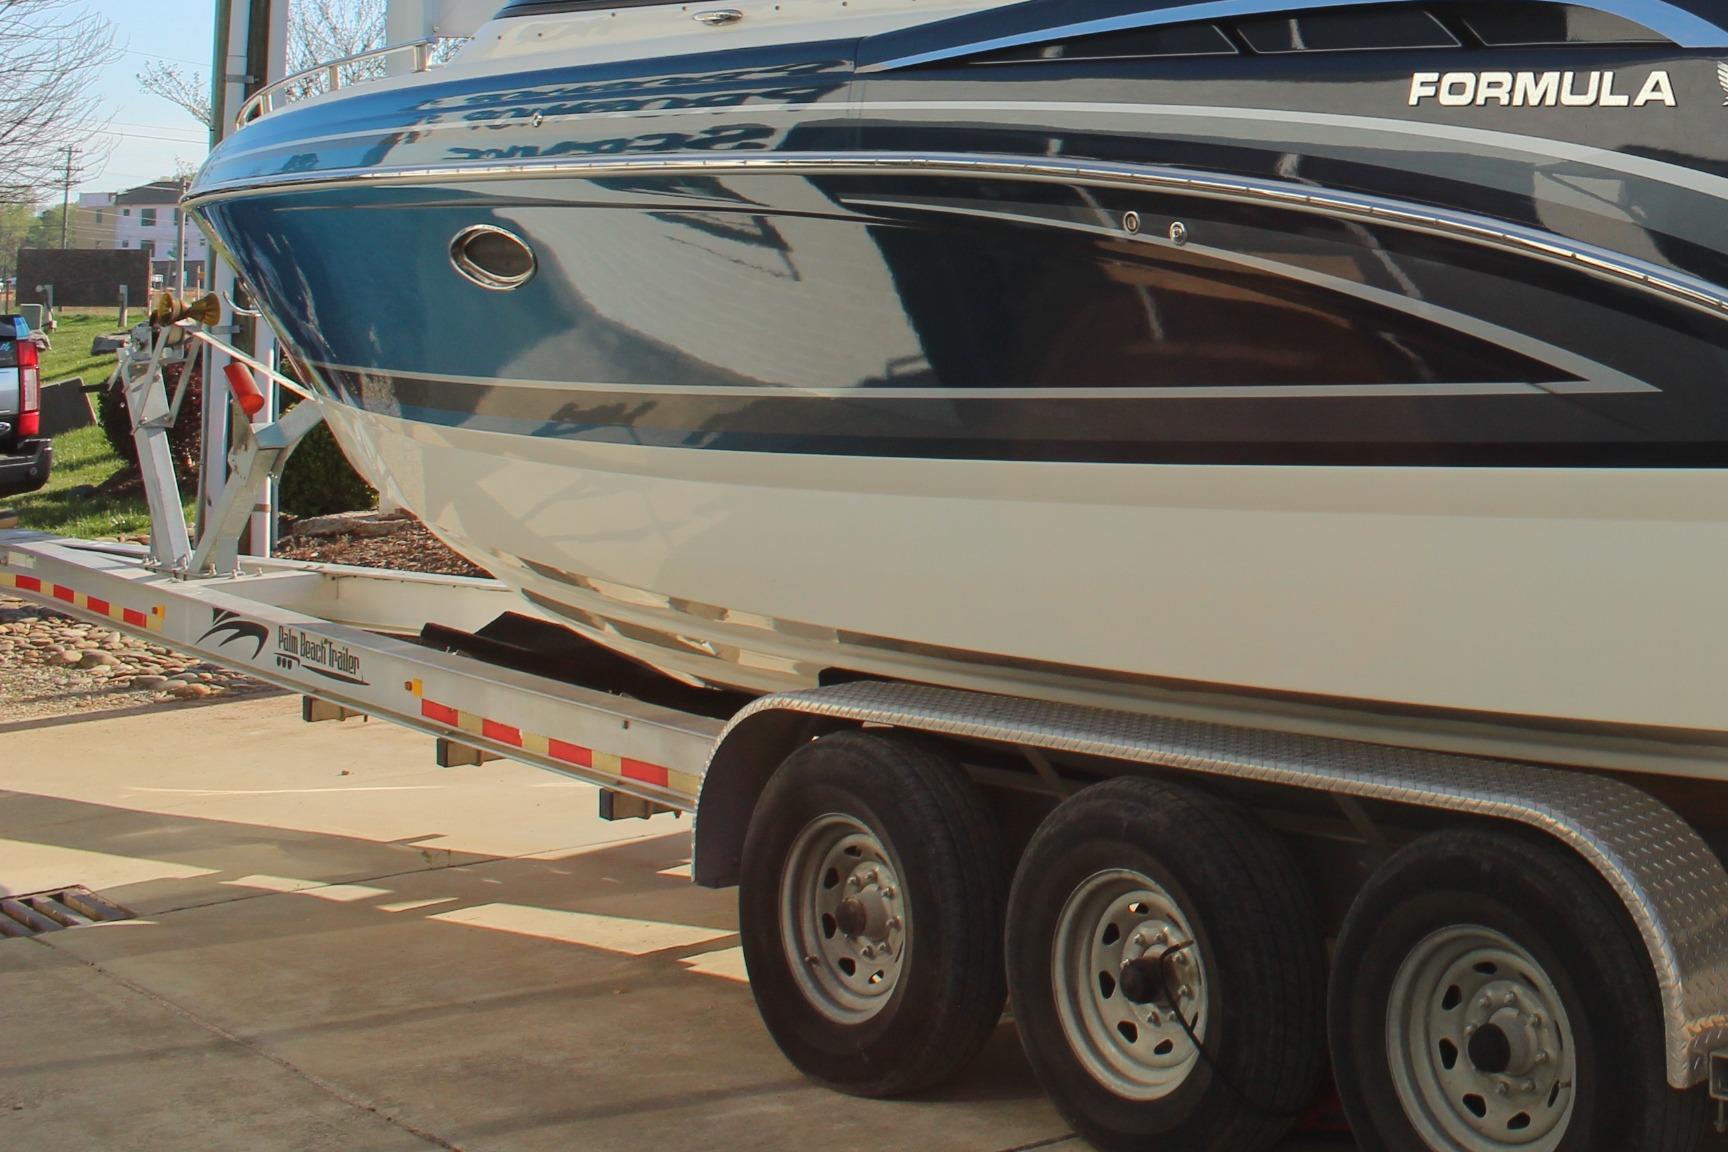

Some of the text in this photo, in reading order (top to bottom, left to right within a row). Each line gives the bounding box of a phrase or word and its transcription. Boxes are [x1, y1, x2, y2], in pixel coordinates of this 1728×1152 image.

[1408, 70, 1677, 108] FORMULA
[278, 625, 360, 675] Palm Beach Trailer
